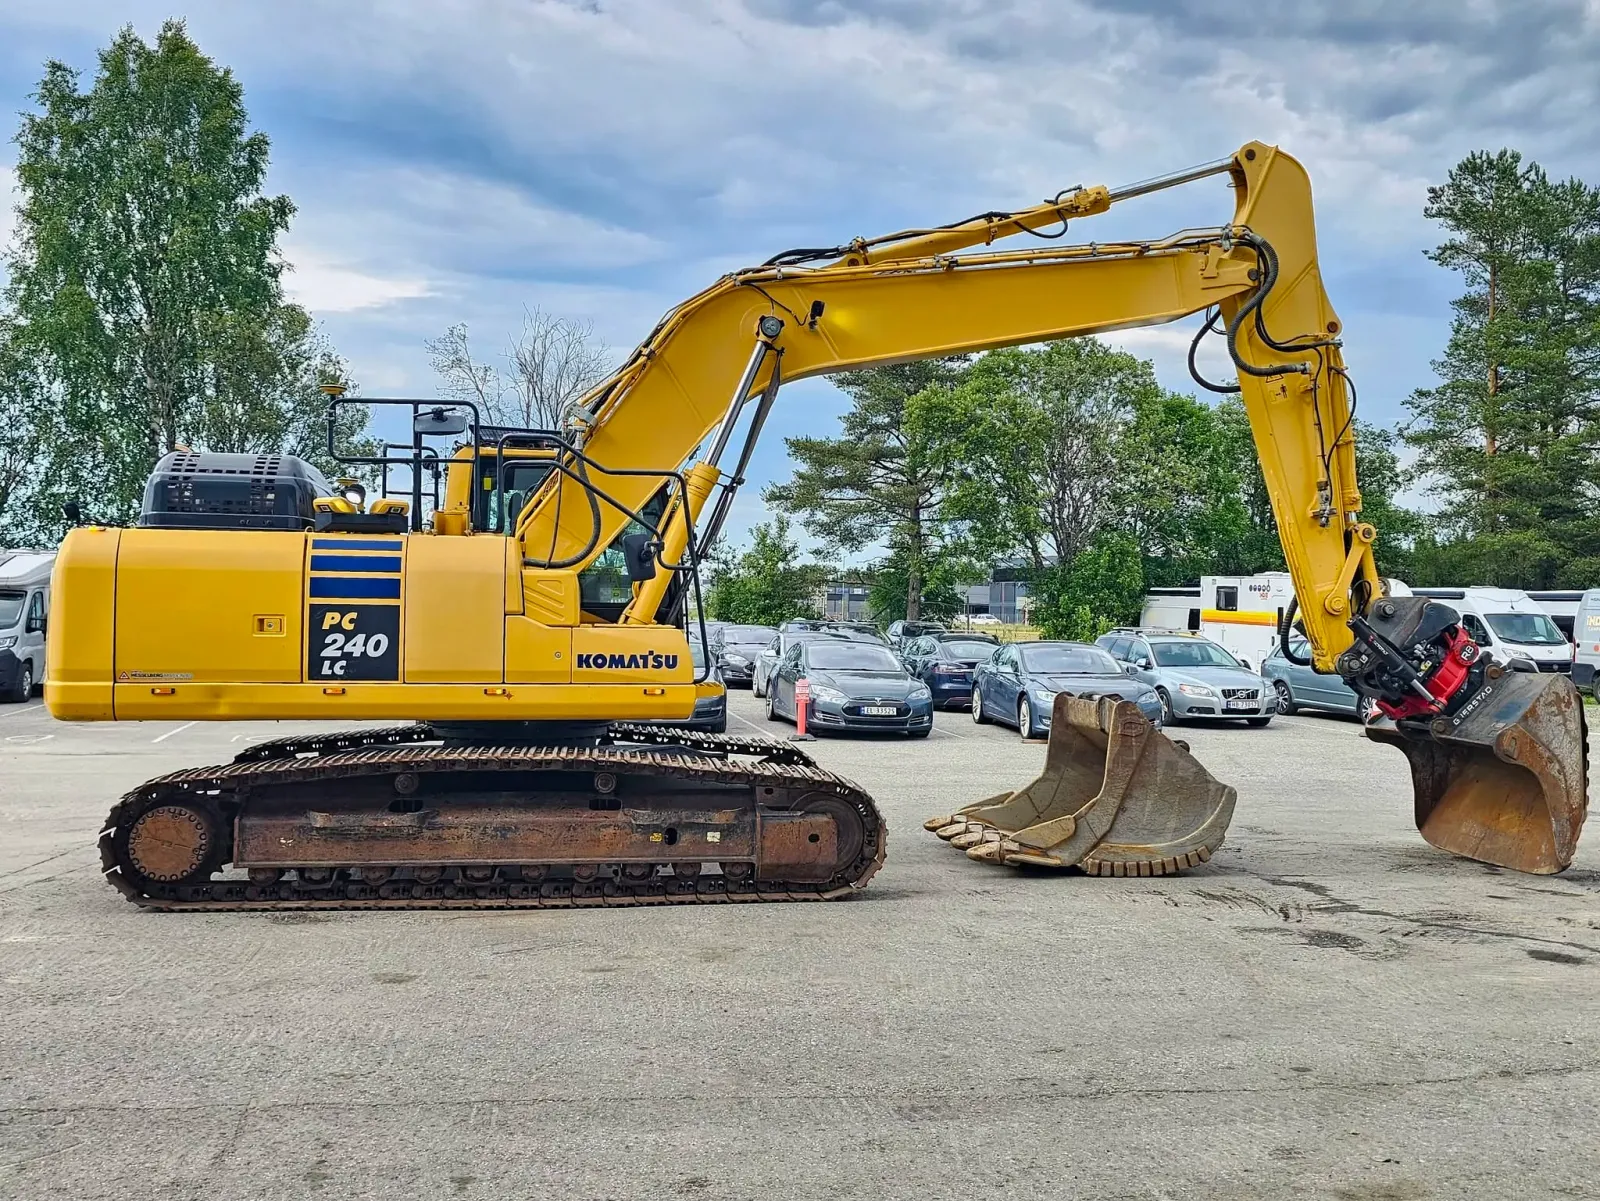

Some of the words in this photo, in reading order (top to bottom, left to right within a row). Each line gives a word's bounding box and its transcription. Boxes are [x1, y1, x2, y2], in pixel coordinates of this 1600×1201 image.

[321, 611, 358, 630] PC
[319, 632, 389, 658] 240
[1460, 645, 1474, 661] R8
[321, 660, 347, 675] LC
[577, 650, 678, 669] KOMATSU
